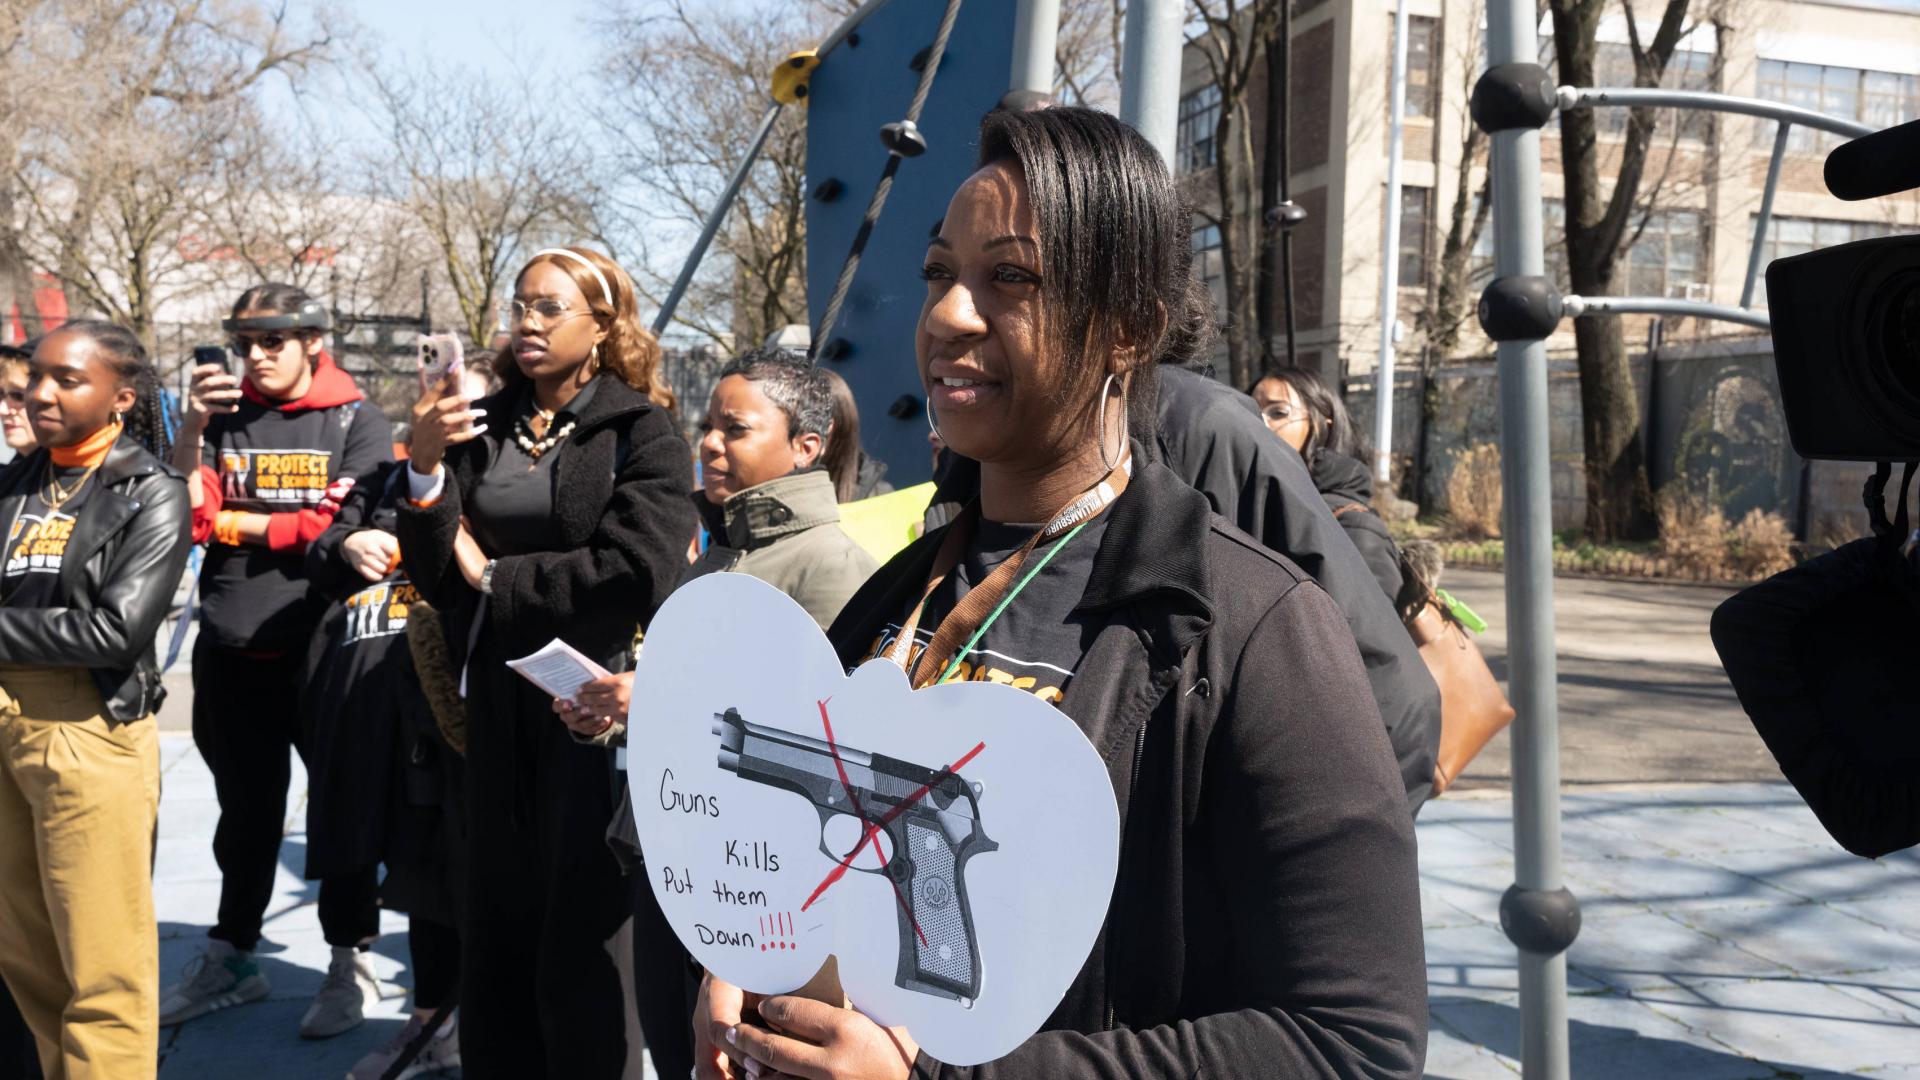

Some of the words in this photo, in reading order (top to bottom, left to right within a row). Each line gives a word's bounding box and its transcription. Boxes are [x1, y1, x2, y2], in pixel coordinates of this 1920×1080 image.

[256, 454, 329, 475] PROTECT
[660, 768, 720, 818] Guns
[726, 839, 780, 872] Kills
[663, 866, 694, 894] Put
[712, 880, 767, 907] them
